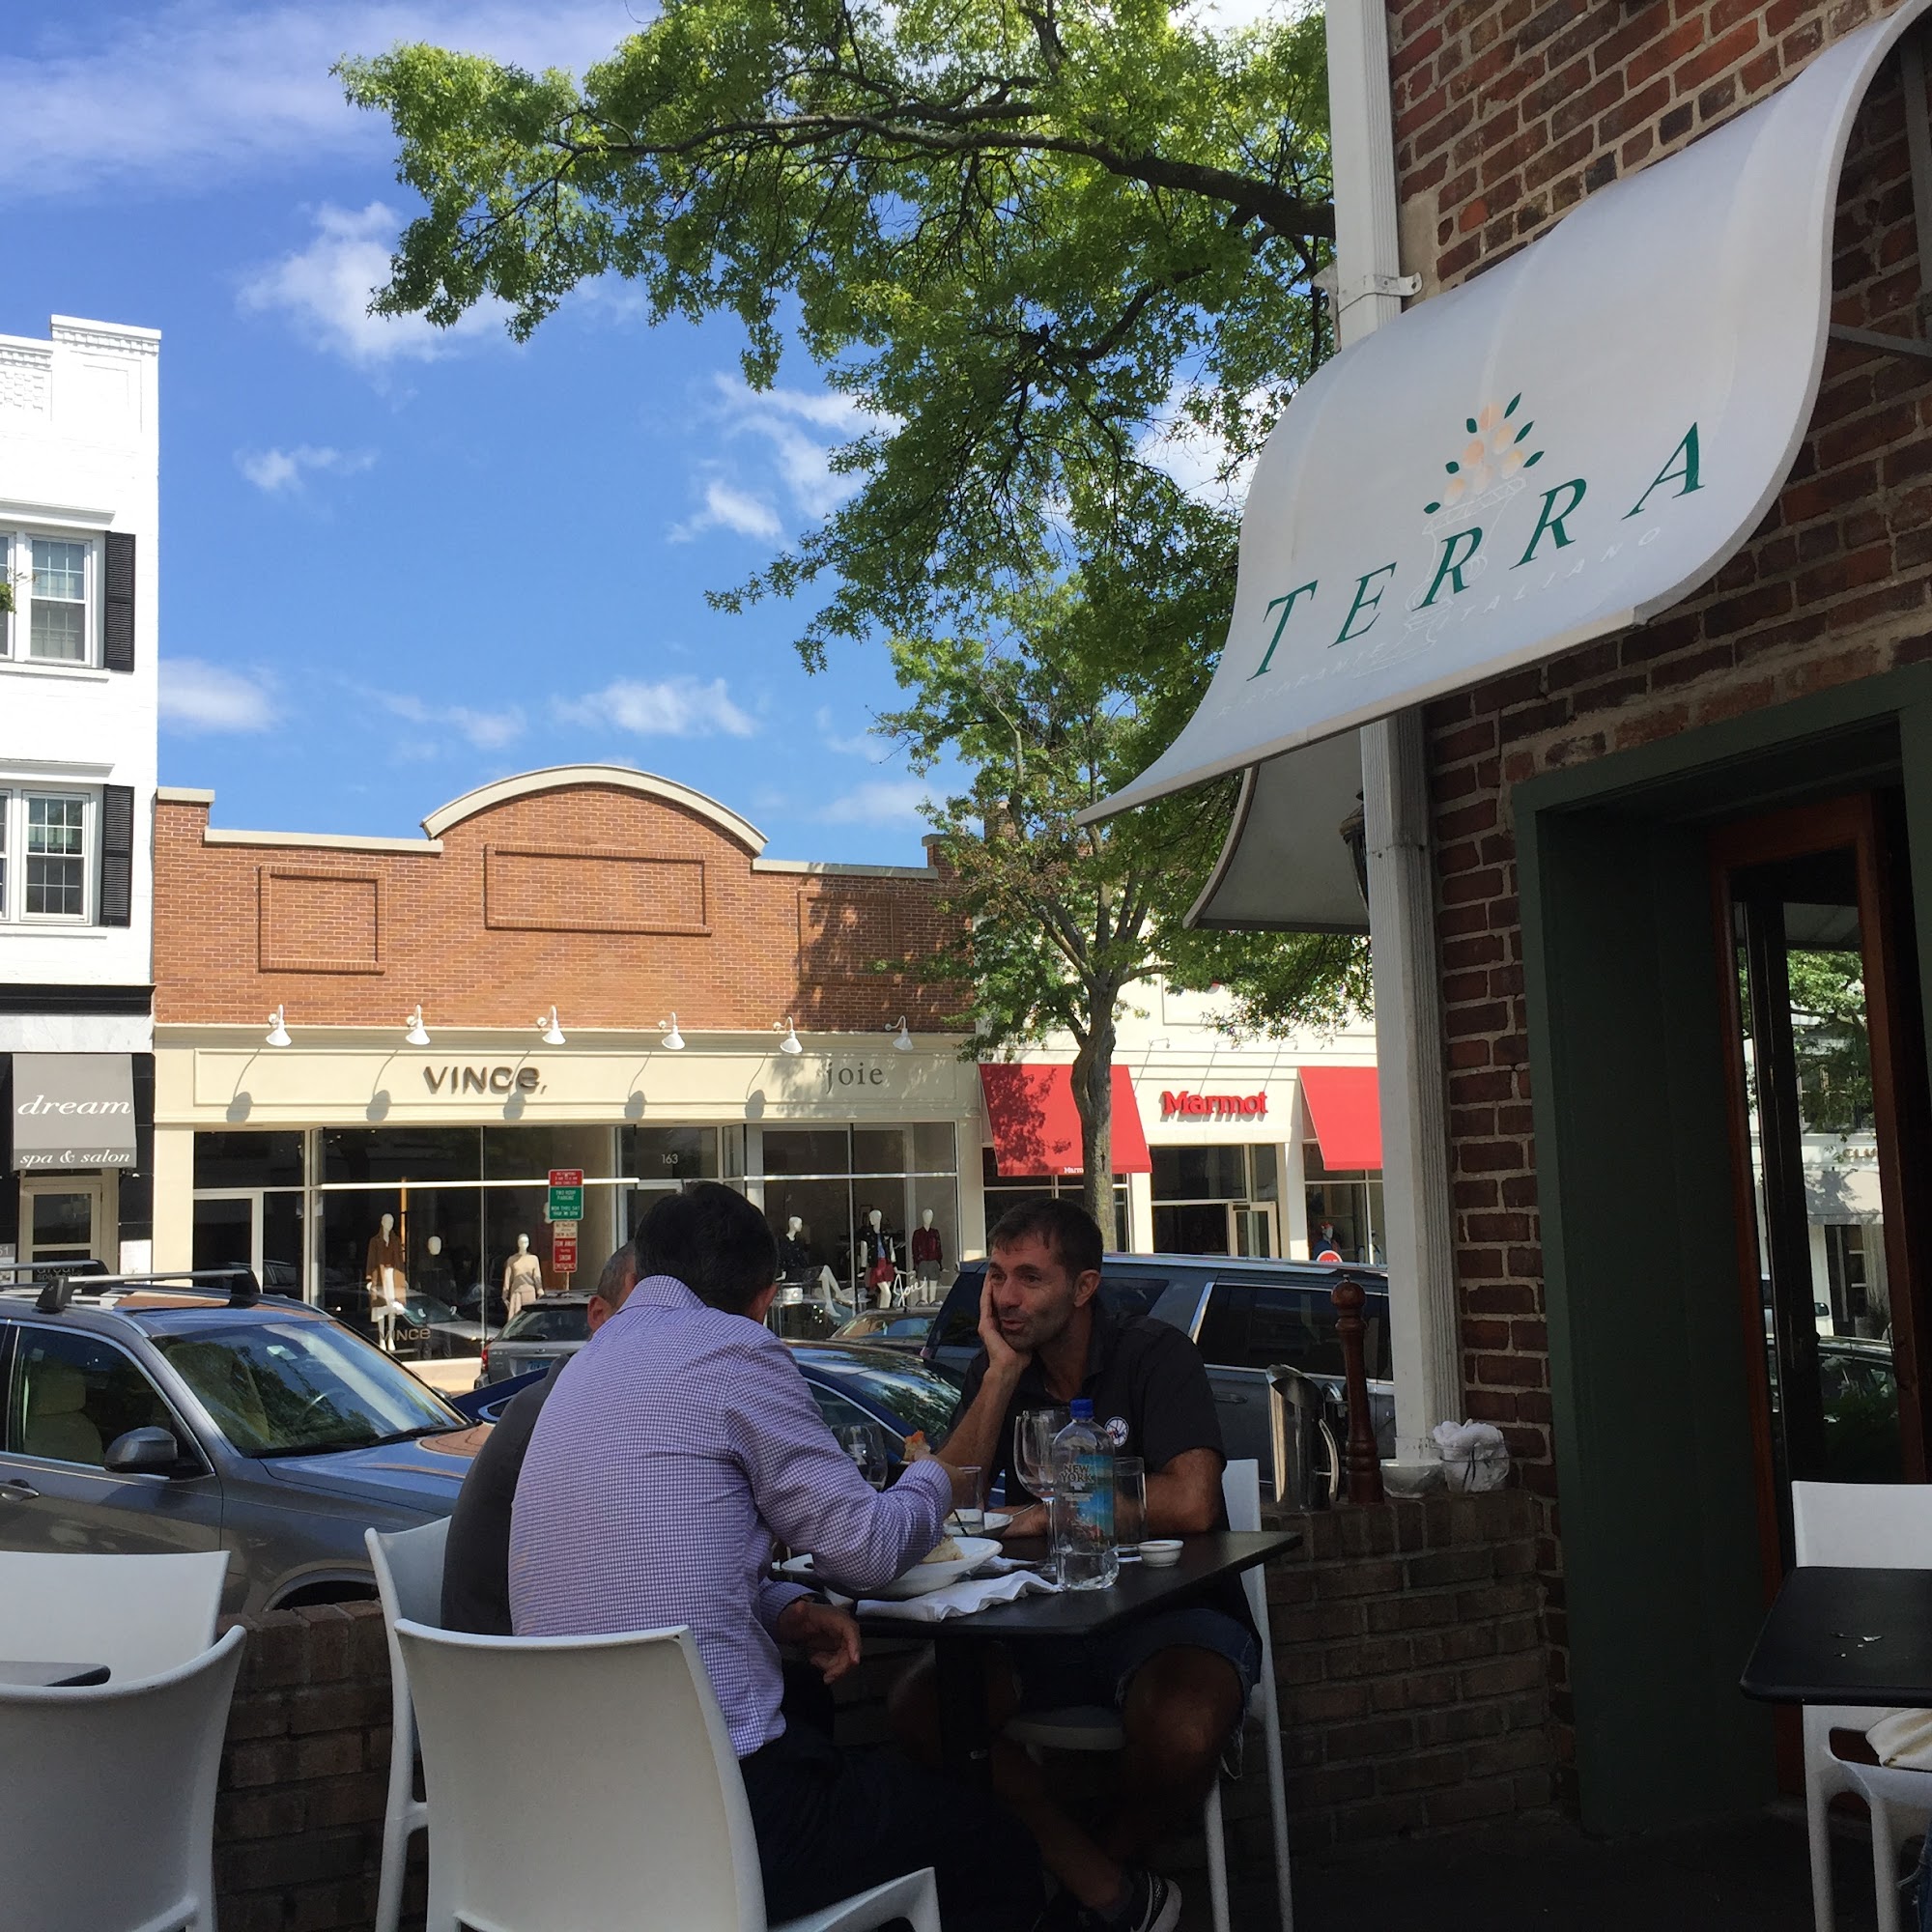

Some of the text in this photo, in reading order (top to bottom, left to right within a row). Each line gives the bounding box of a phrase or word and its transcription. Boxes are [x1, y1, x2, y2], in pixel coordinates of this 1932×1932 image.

[1246, 421, 1705, 682] TERRA
[826, 1062, 883, 1094] joie
[17, 1094, 130, 1115] dream
[1161, 1091, 1269, 1114] Marmot
[19, 1149, 130, 1168] spa & salon
[661, 1152, 679, 1165] 163
[893, 1273, 927, 1307] Joie
[1059, 1472, 1094, 1483] YORK
[1064, 1463, 1090, 1473] NEW
